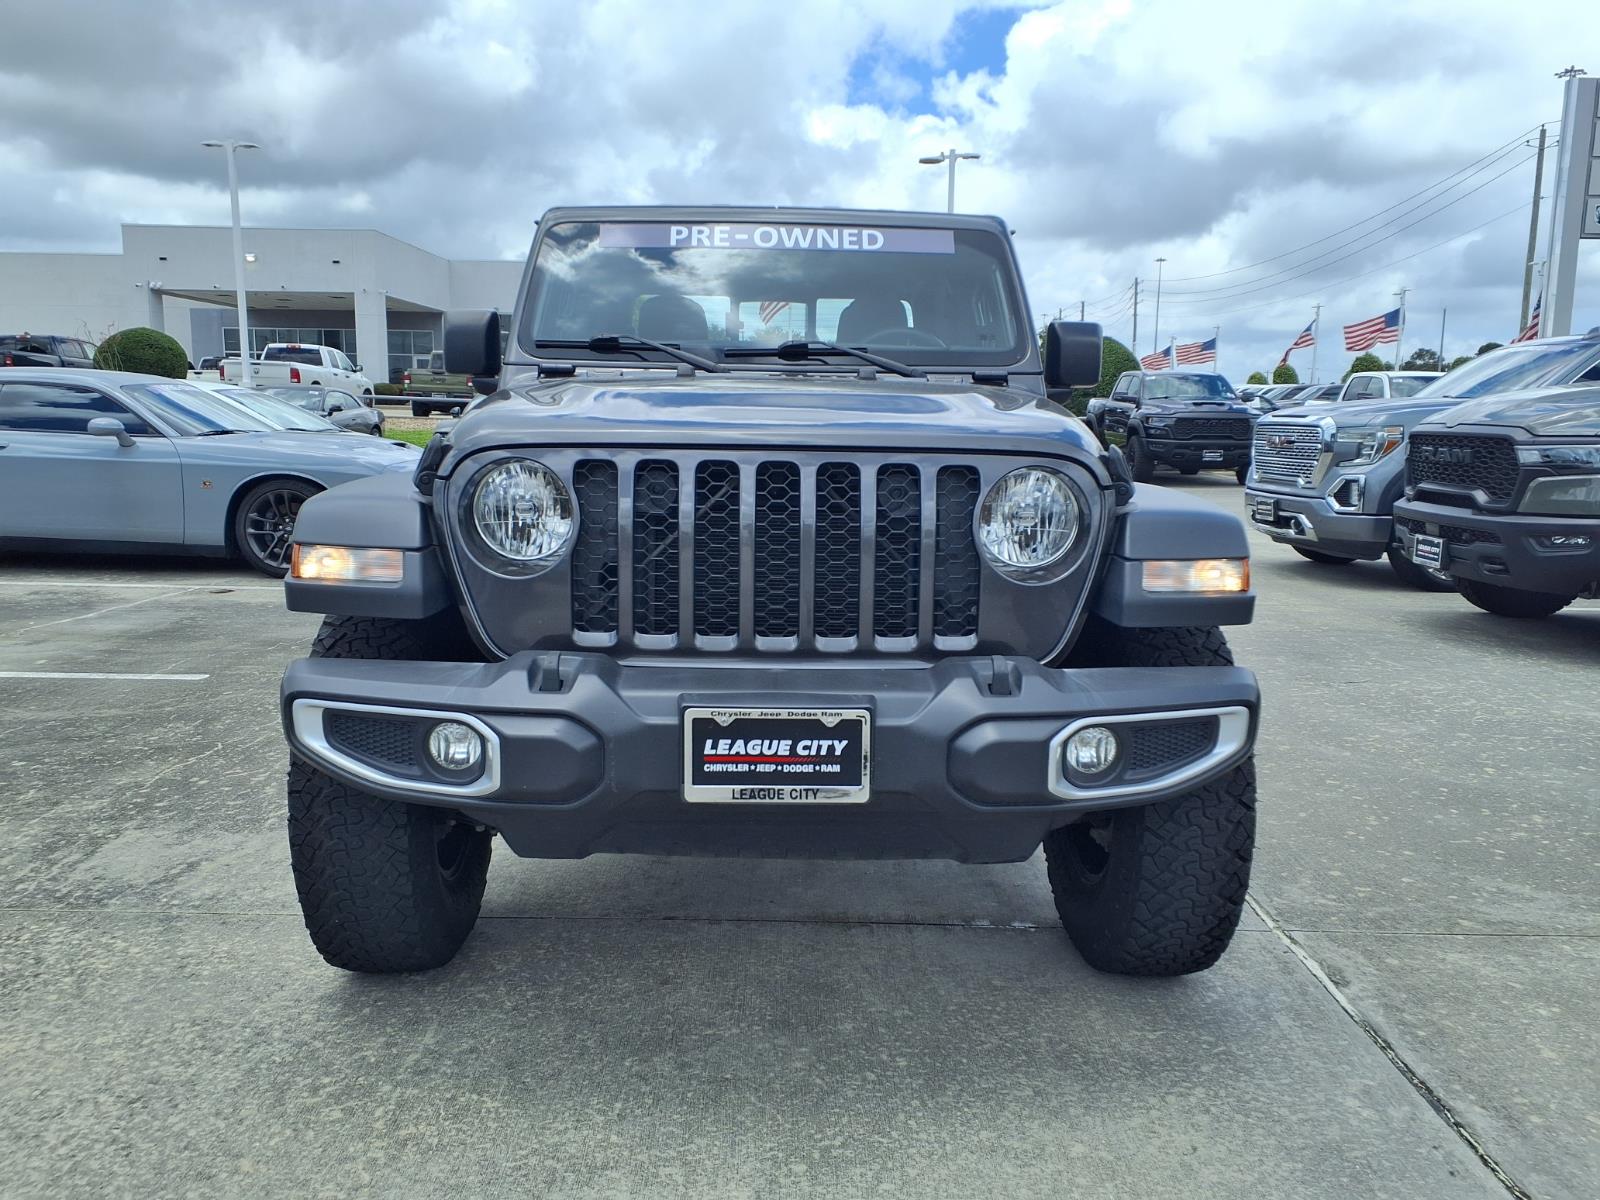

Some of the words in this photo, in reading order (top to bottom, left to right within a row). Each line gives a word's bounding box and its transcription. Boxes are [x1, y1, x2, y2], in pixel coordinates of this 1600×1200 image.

[670, 226, 884, 250] PRE-OWNED
[1421, 445, 1473, 464] RAM
[710, 710, 752, 718] Chrysler
[757, 710, 782, 718] Jeep
[787, 710, 818, 718] Dodge
[704, 739, 791, 755] LEAGUE
[797, 739, 848, 755] CITY
[703, 763, 749, 772] CHRYSLER
[755, 764, 776, 772] JEEP
[783, 764, 814, 772] DODGE
[820, 764, 841, 772] RAM
[732, 788, 785, 800] LEAGUE
[789, 788, 820, 800] CITY
